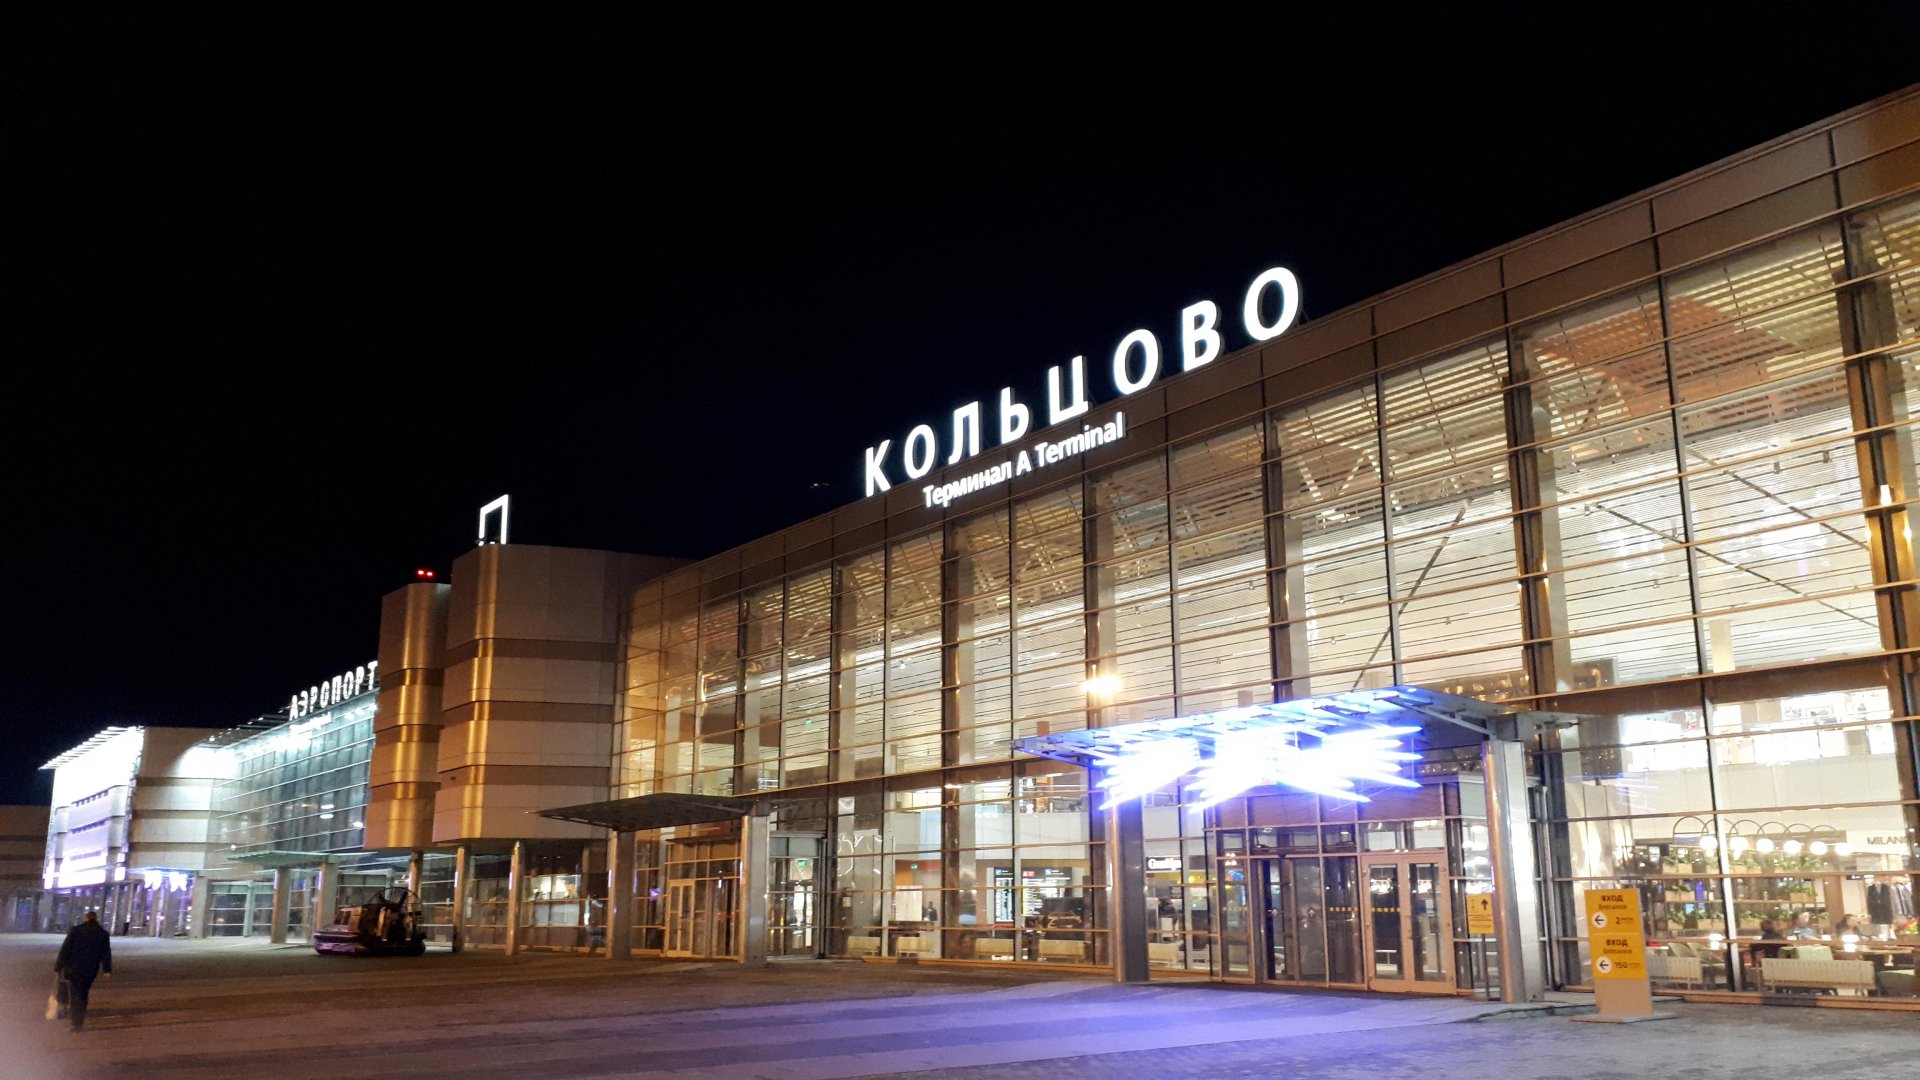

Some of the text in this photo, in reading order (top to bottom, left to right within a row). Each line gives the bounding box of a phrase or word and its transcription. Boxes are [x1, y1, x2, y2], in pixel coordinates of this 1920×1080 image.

[864, 266, 1301, 498] КОЛЬЦОВО
[922, 460, 1013, 508] Терминал
[1034, 411, 1125, 468] Terminal
[289, 660, 378, 721] АЭРОПОРТ
[1866, 836, 1908, 845] MILAN
[1605, 939, 1628, 947] ВХОД
